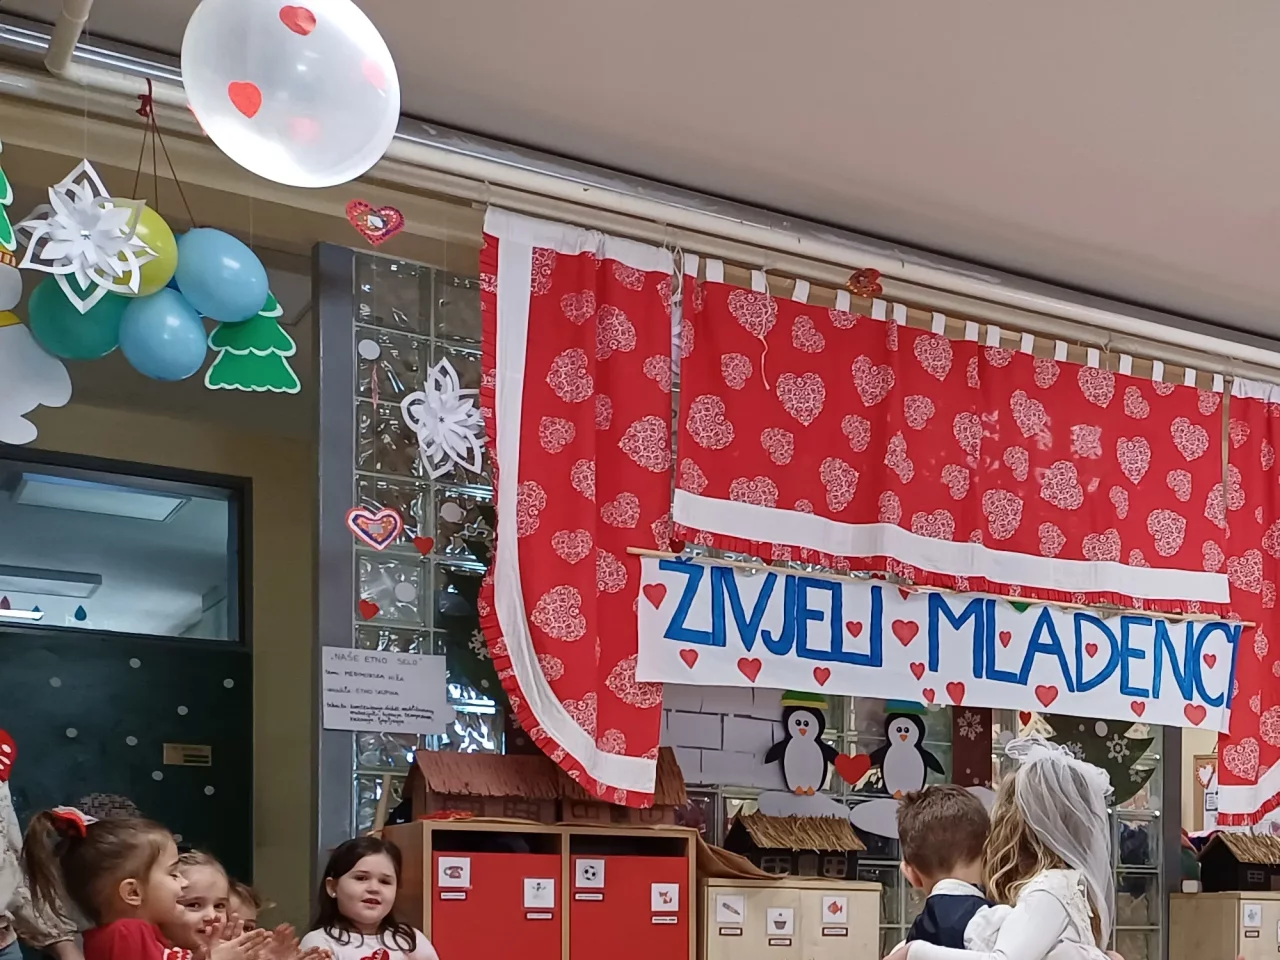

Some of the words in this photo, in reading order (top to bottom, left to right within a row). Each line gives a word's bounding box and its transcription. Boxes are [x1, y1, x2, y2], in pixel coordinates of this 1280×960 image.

[364, 656, 388, 665] ETNO
[659, 557, 883, 668] ŽIVJELI
[928, 592, 1242, 710] MLADENCI
